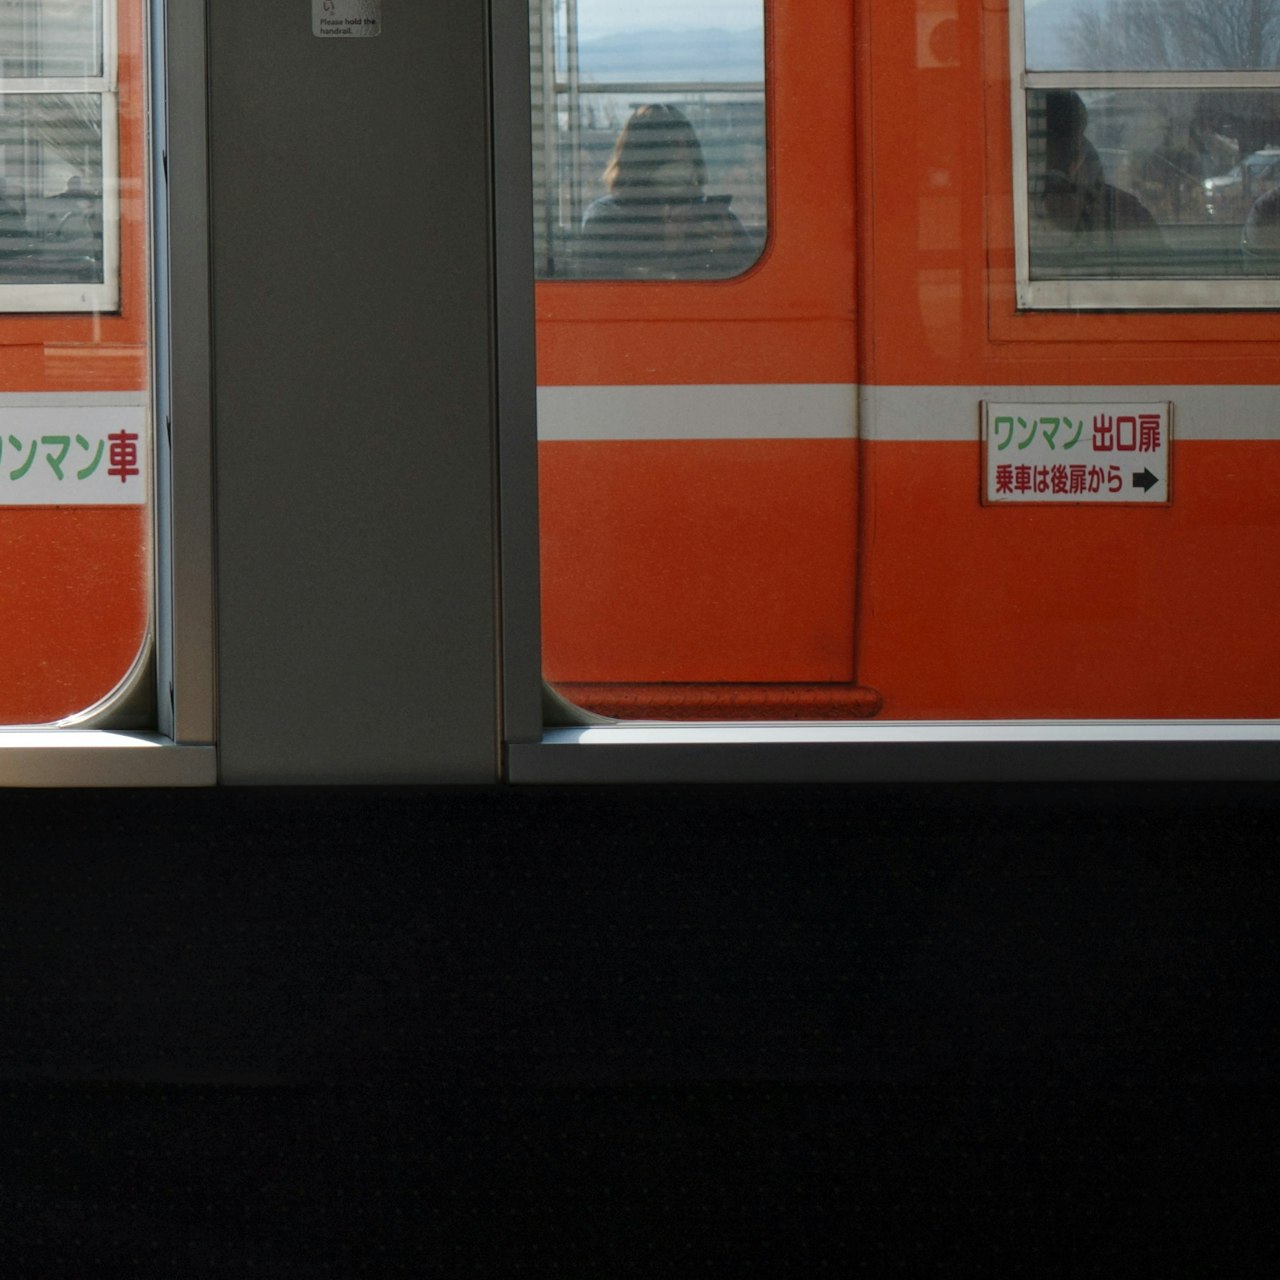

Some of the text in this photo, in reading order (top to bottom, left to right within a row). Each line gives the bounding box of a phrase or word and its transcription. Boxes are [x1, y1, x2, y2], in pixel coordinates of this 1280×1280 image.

[320, 17, 377, 26] Please hold the
[994, 413, 1161, 453] ワンマン 出口扉
[995, 464, 1123, 494] 乗車は後扉から
